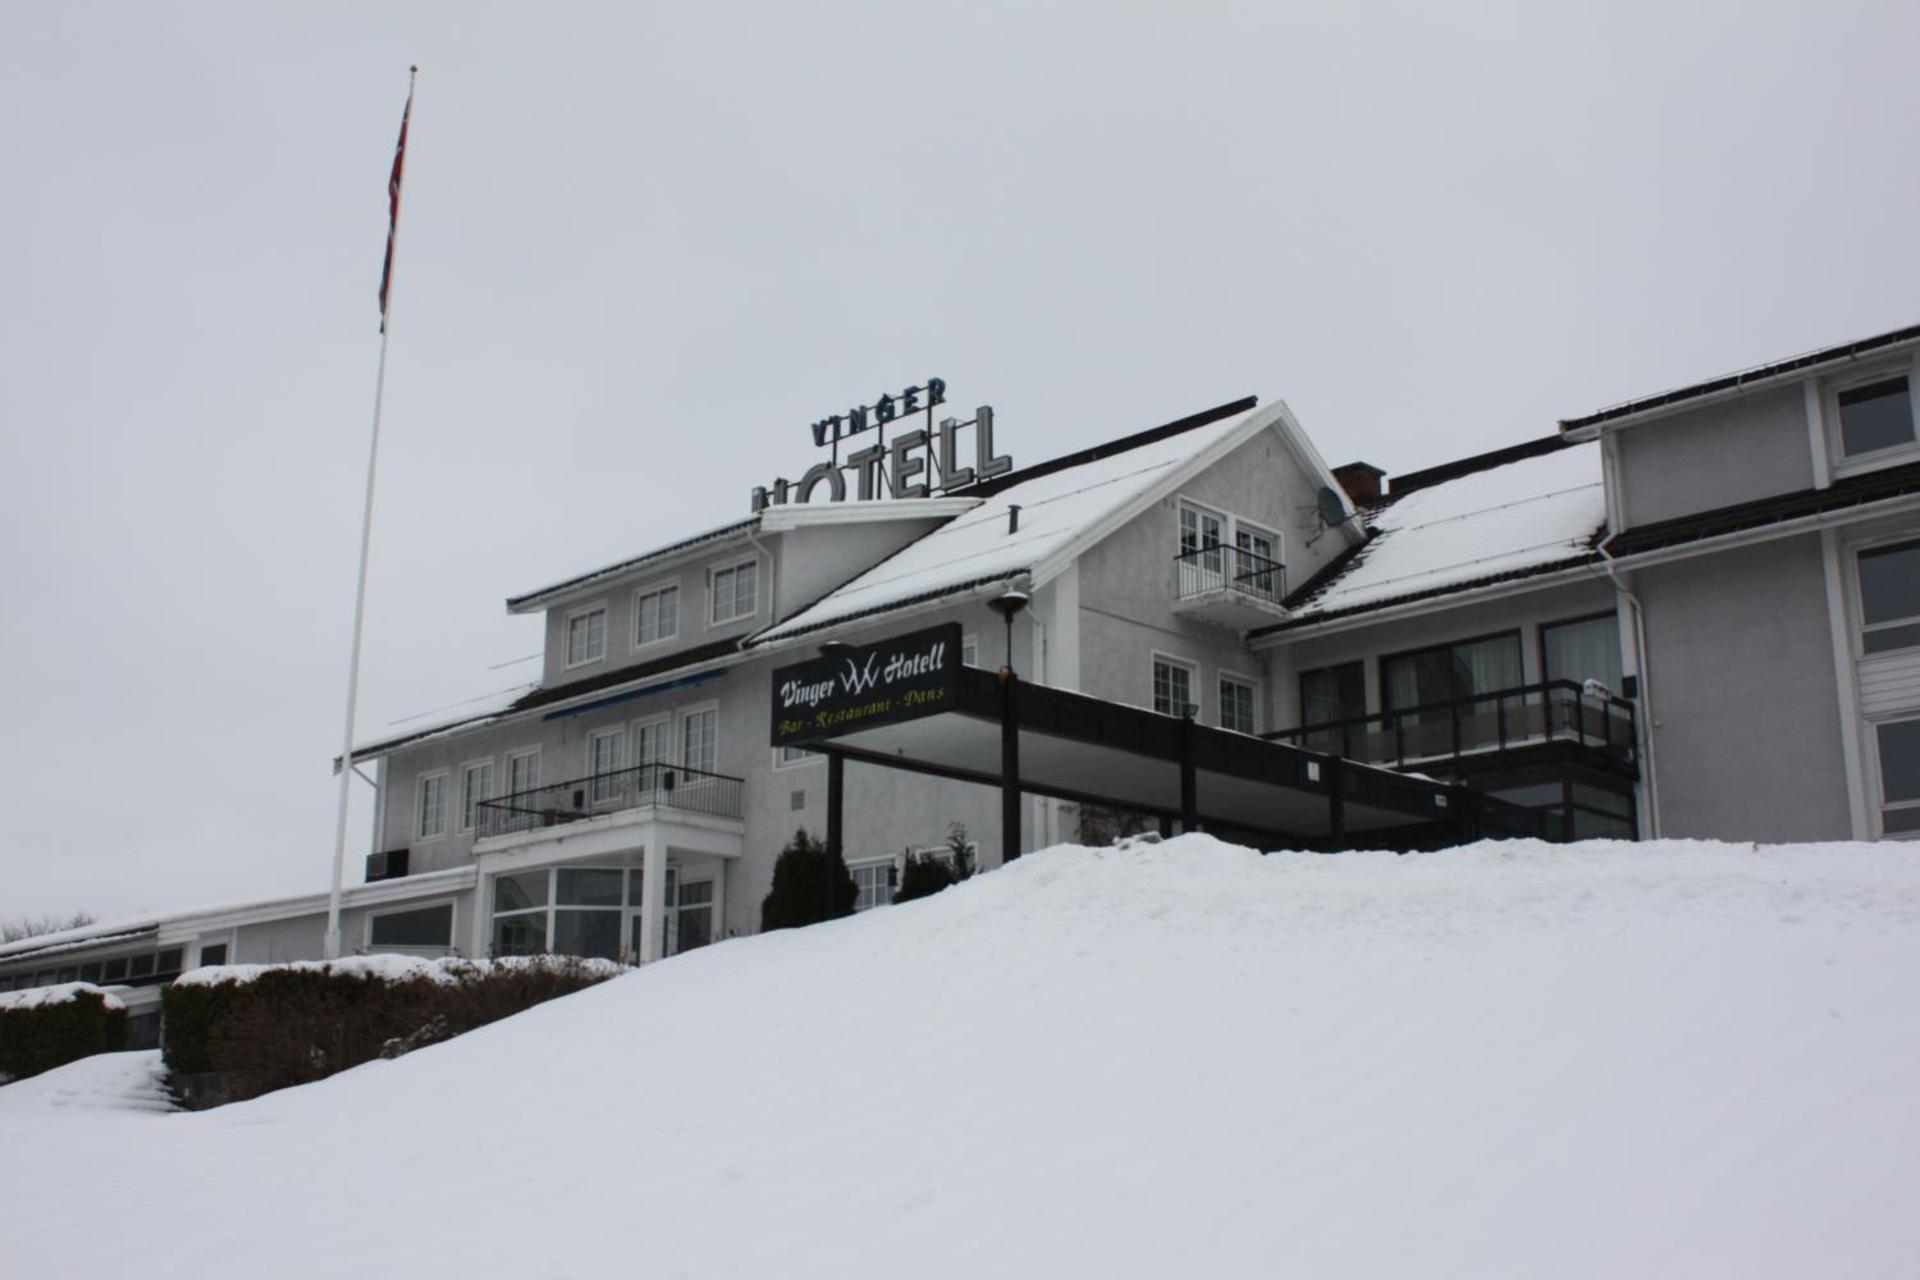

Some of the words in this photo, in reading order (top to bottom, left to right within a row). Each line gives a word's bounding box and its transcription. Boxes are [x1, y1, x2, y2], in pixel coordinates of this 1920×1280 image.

[811, 377, 946, 446] VINGER
[780, 679, 836, 708] Vinger
[884, 641, 946, 684] Hotell
[779, 720, 805, 736] Bar
[816, 699, 891, 728] Restaurant
[904, 687, 946, 707] Dans
